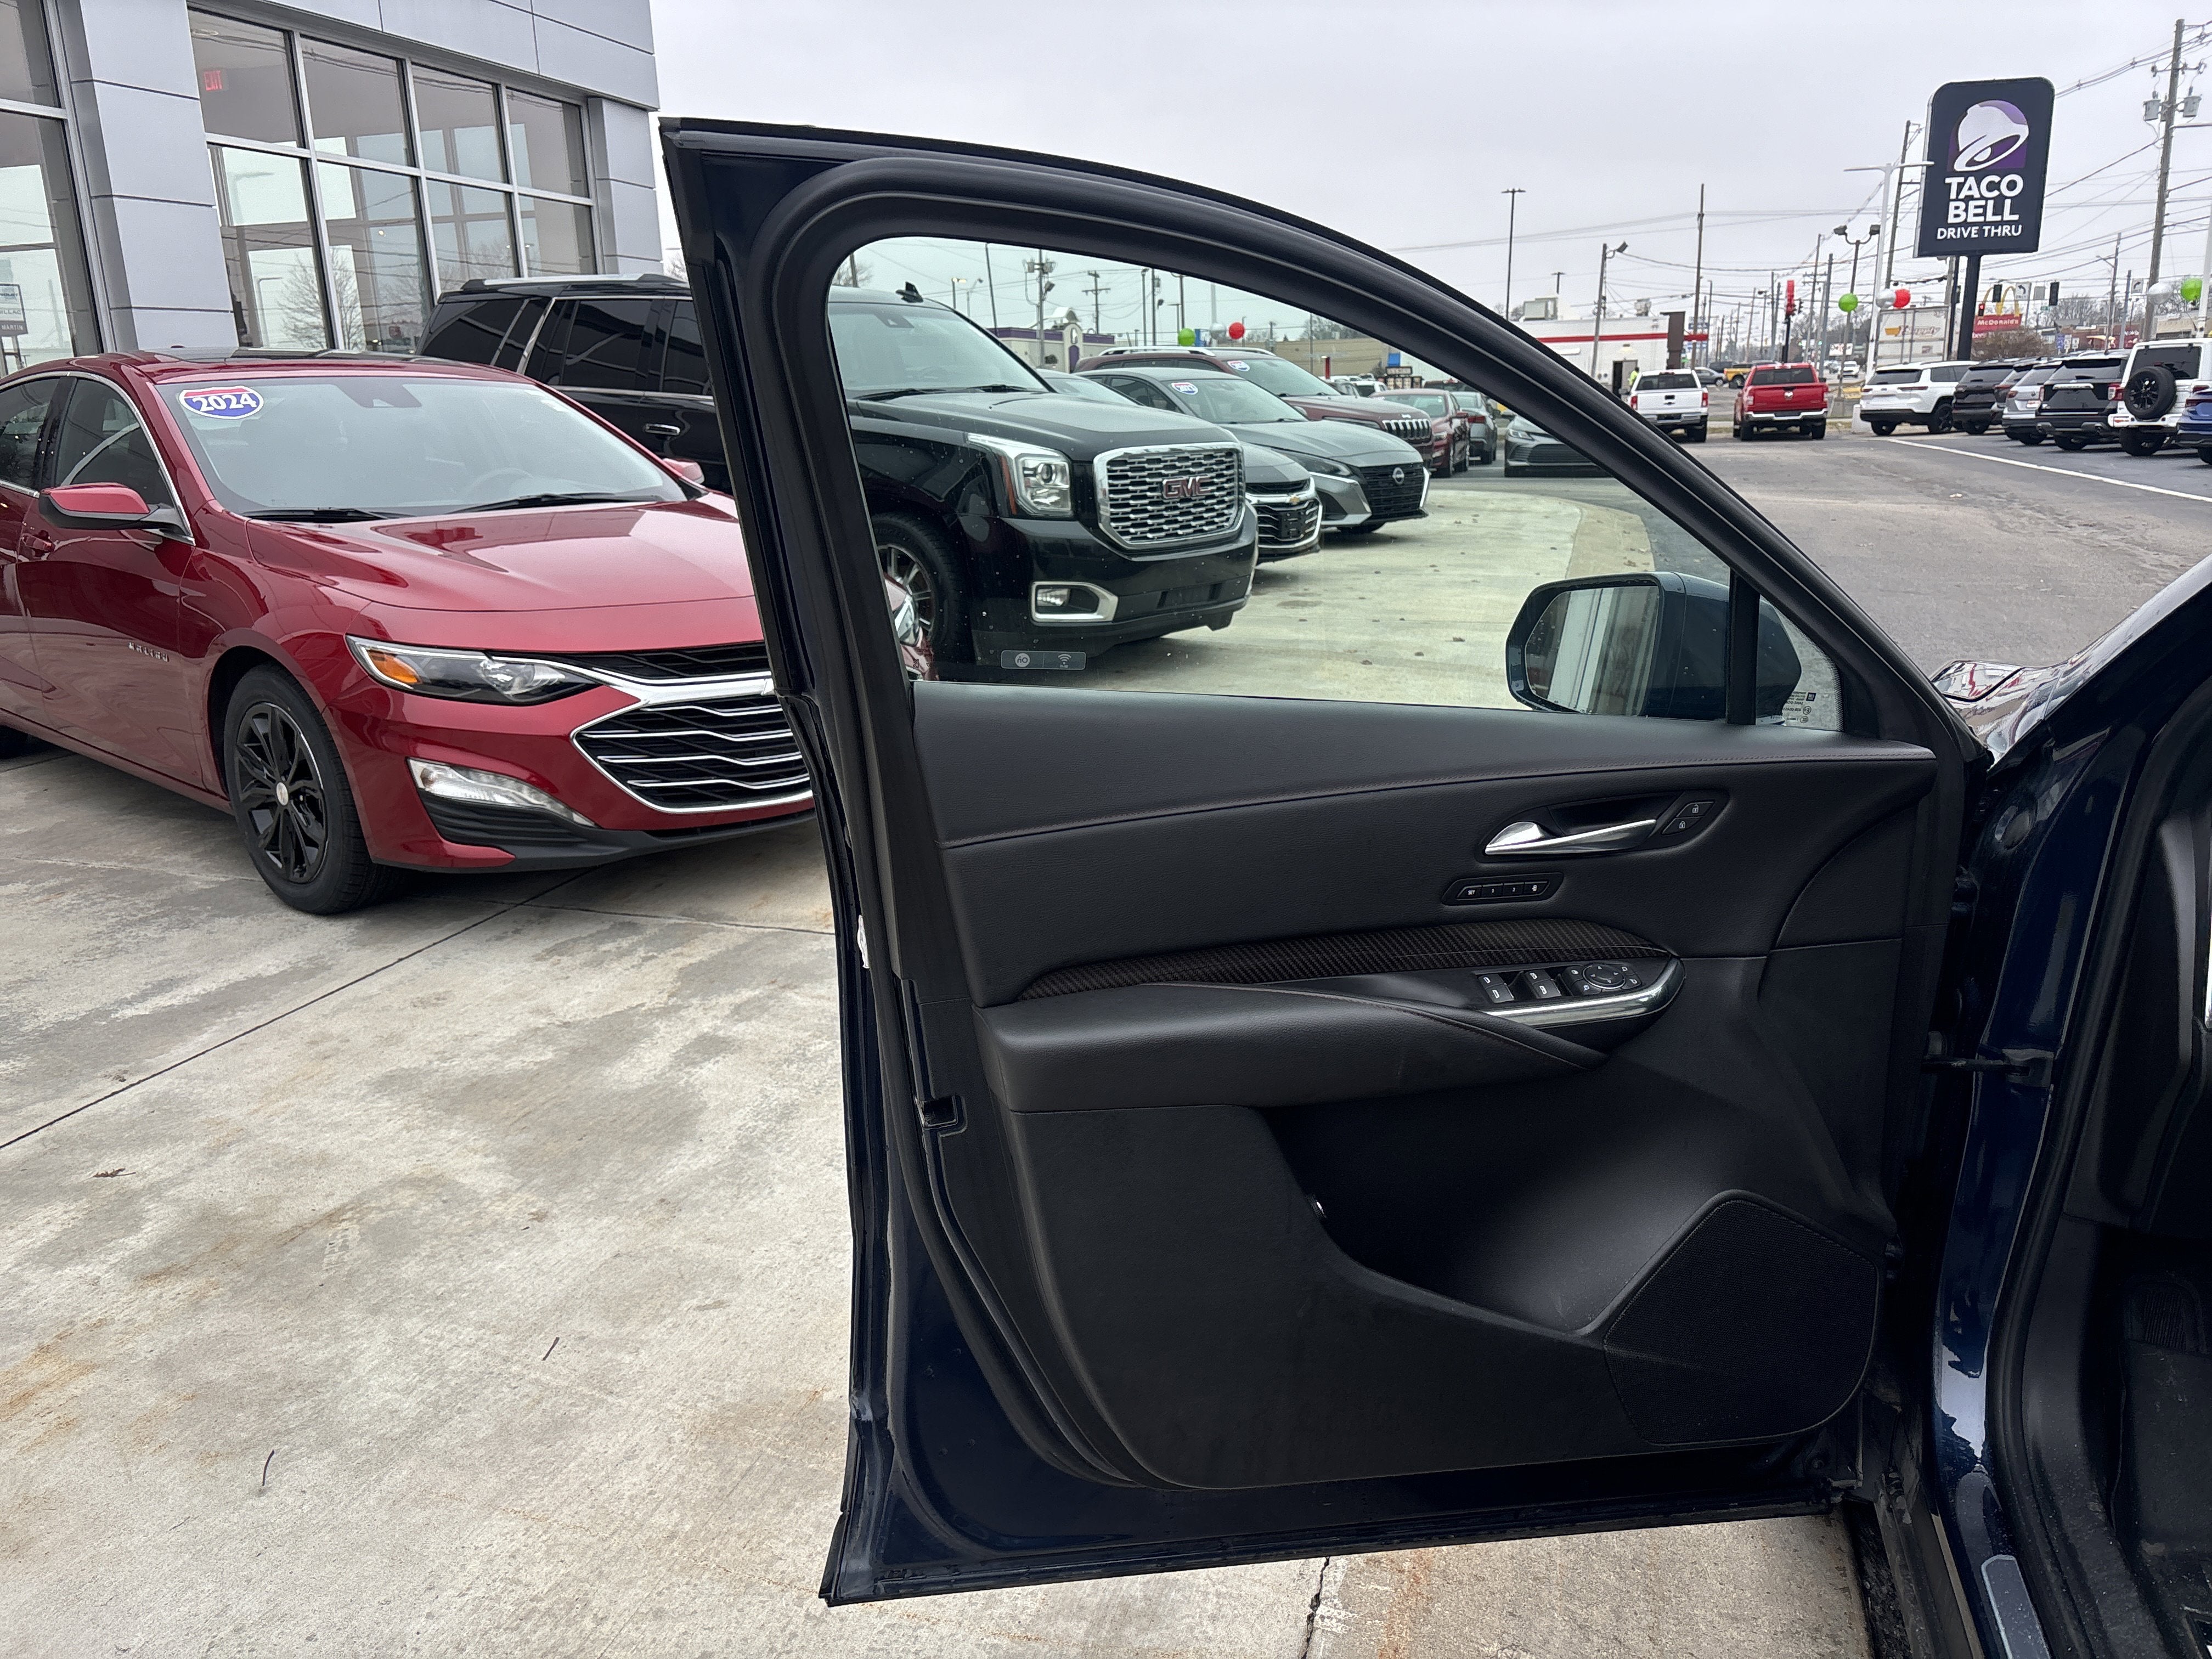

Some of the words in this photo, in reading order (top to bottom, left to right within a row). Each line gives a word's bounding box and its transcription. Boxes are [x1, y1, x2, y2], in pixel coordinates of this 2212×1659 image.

[204, 70, 222, 91] EXIT
[1945, 173, 2024, 200] TACO
[1947, 199, 2019, 223] BELL
[1937, 226, 1979, 240] DRIVE
[1983, 224, 2022, 238] THRU
[192, 393, 257, 411] 2024
[1163, 476, 1211, 499] GMC
